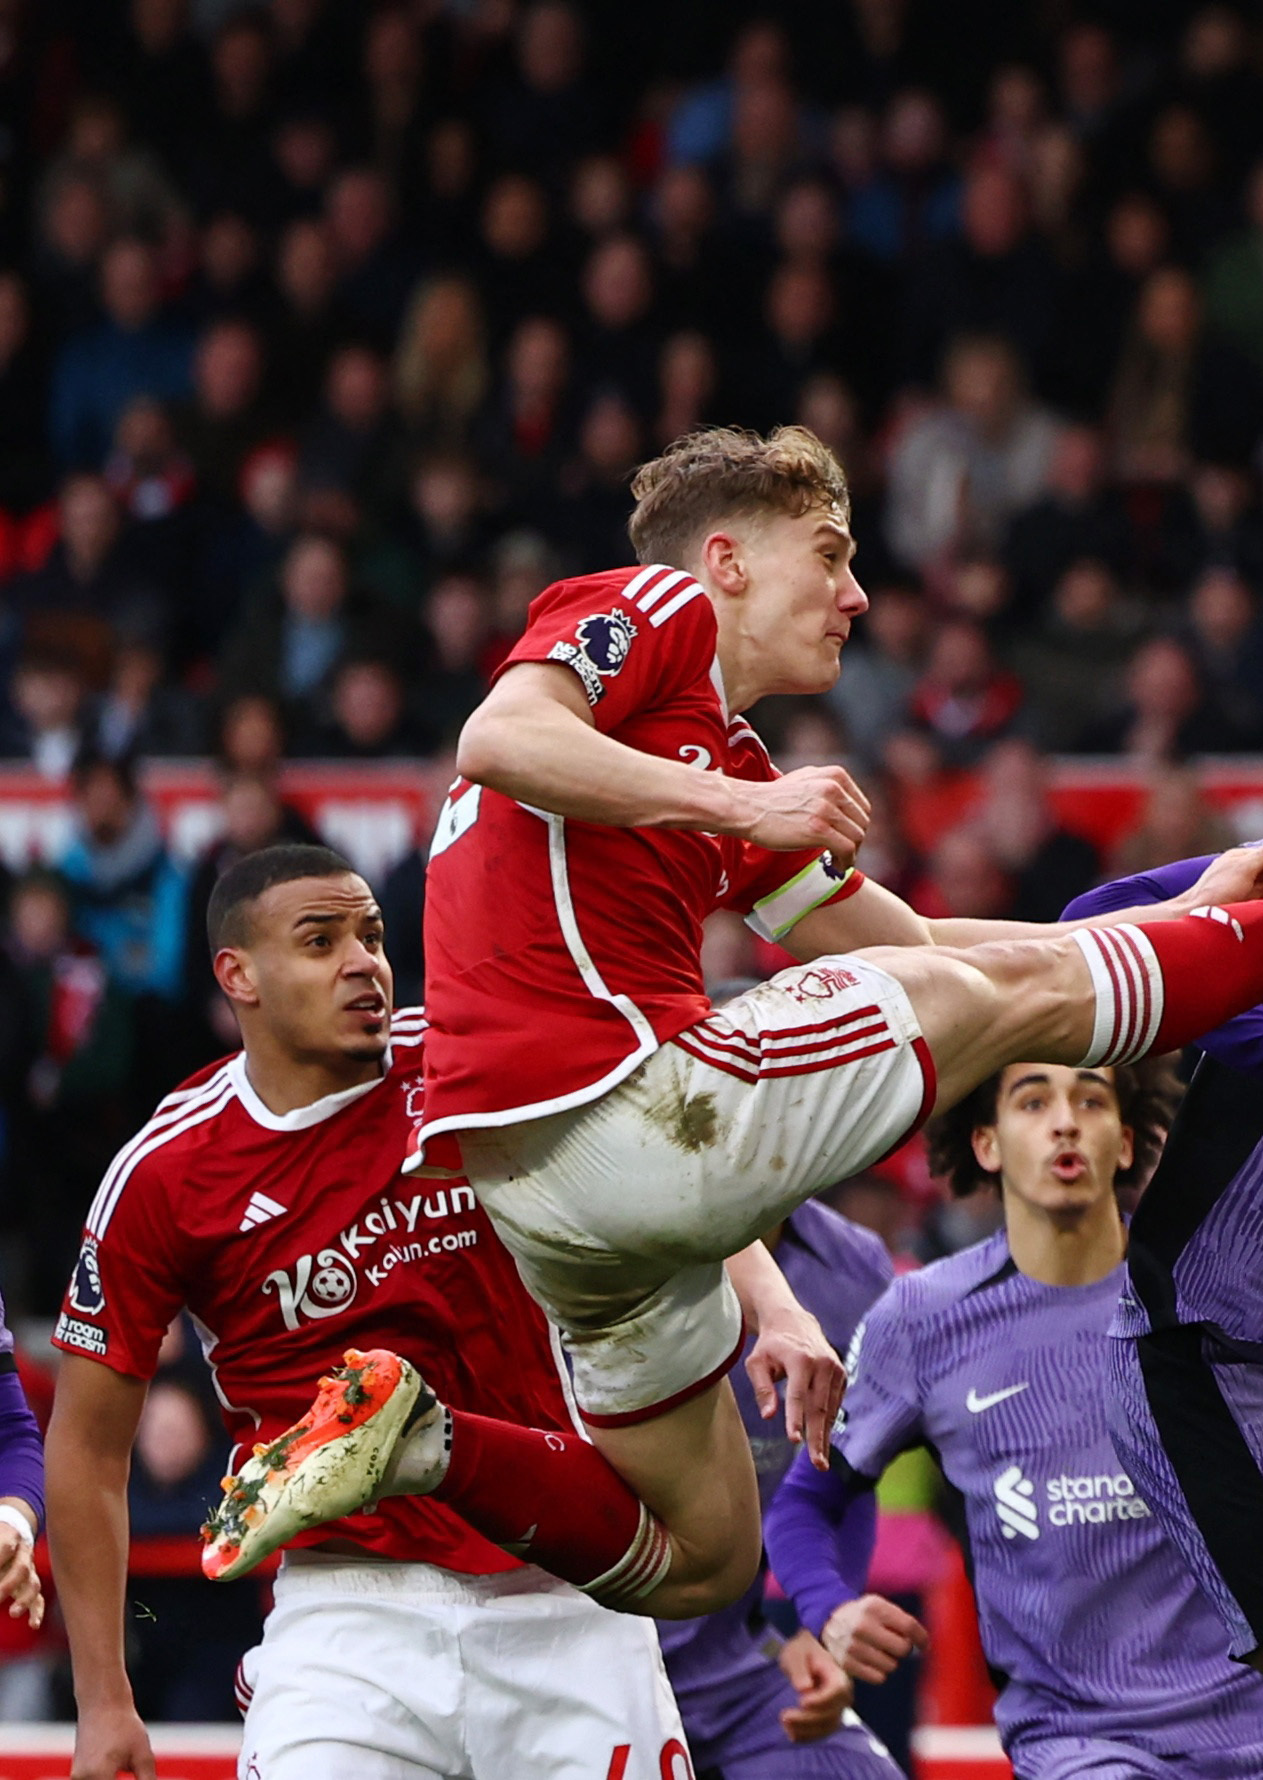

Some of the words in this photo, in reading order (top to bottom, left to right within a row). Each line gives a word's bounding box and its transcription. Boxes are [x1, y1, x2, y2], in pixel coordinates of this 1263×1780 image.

[340, 1185, 477, 1260] Kaiyun
[367, 1447, 380, 1476] COPA
[1048, 1497, 1153, 1527] charte
